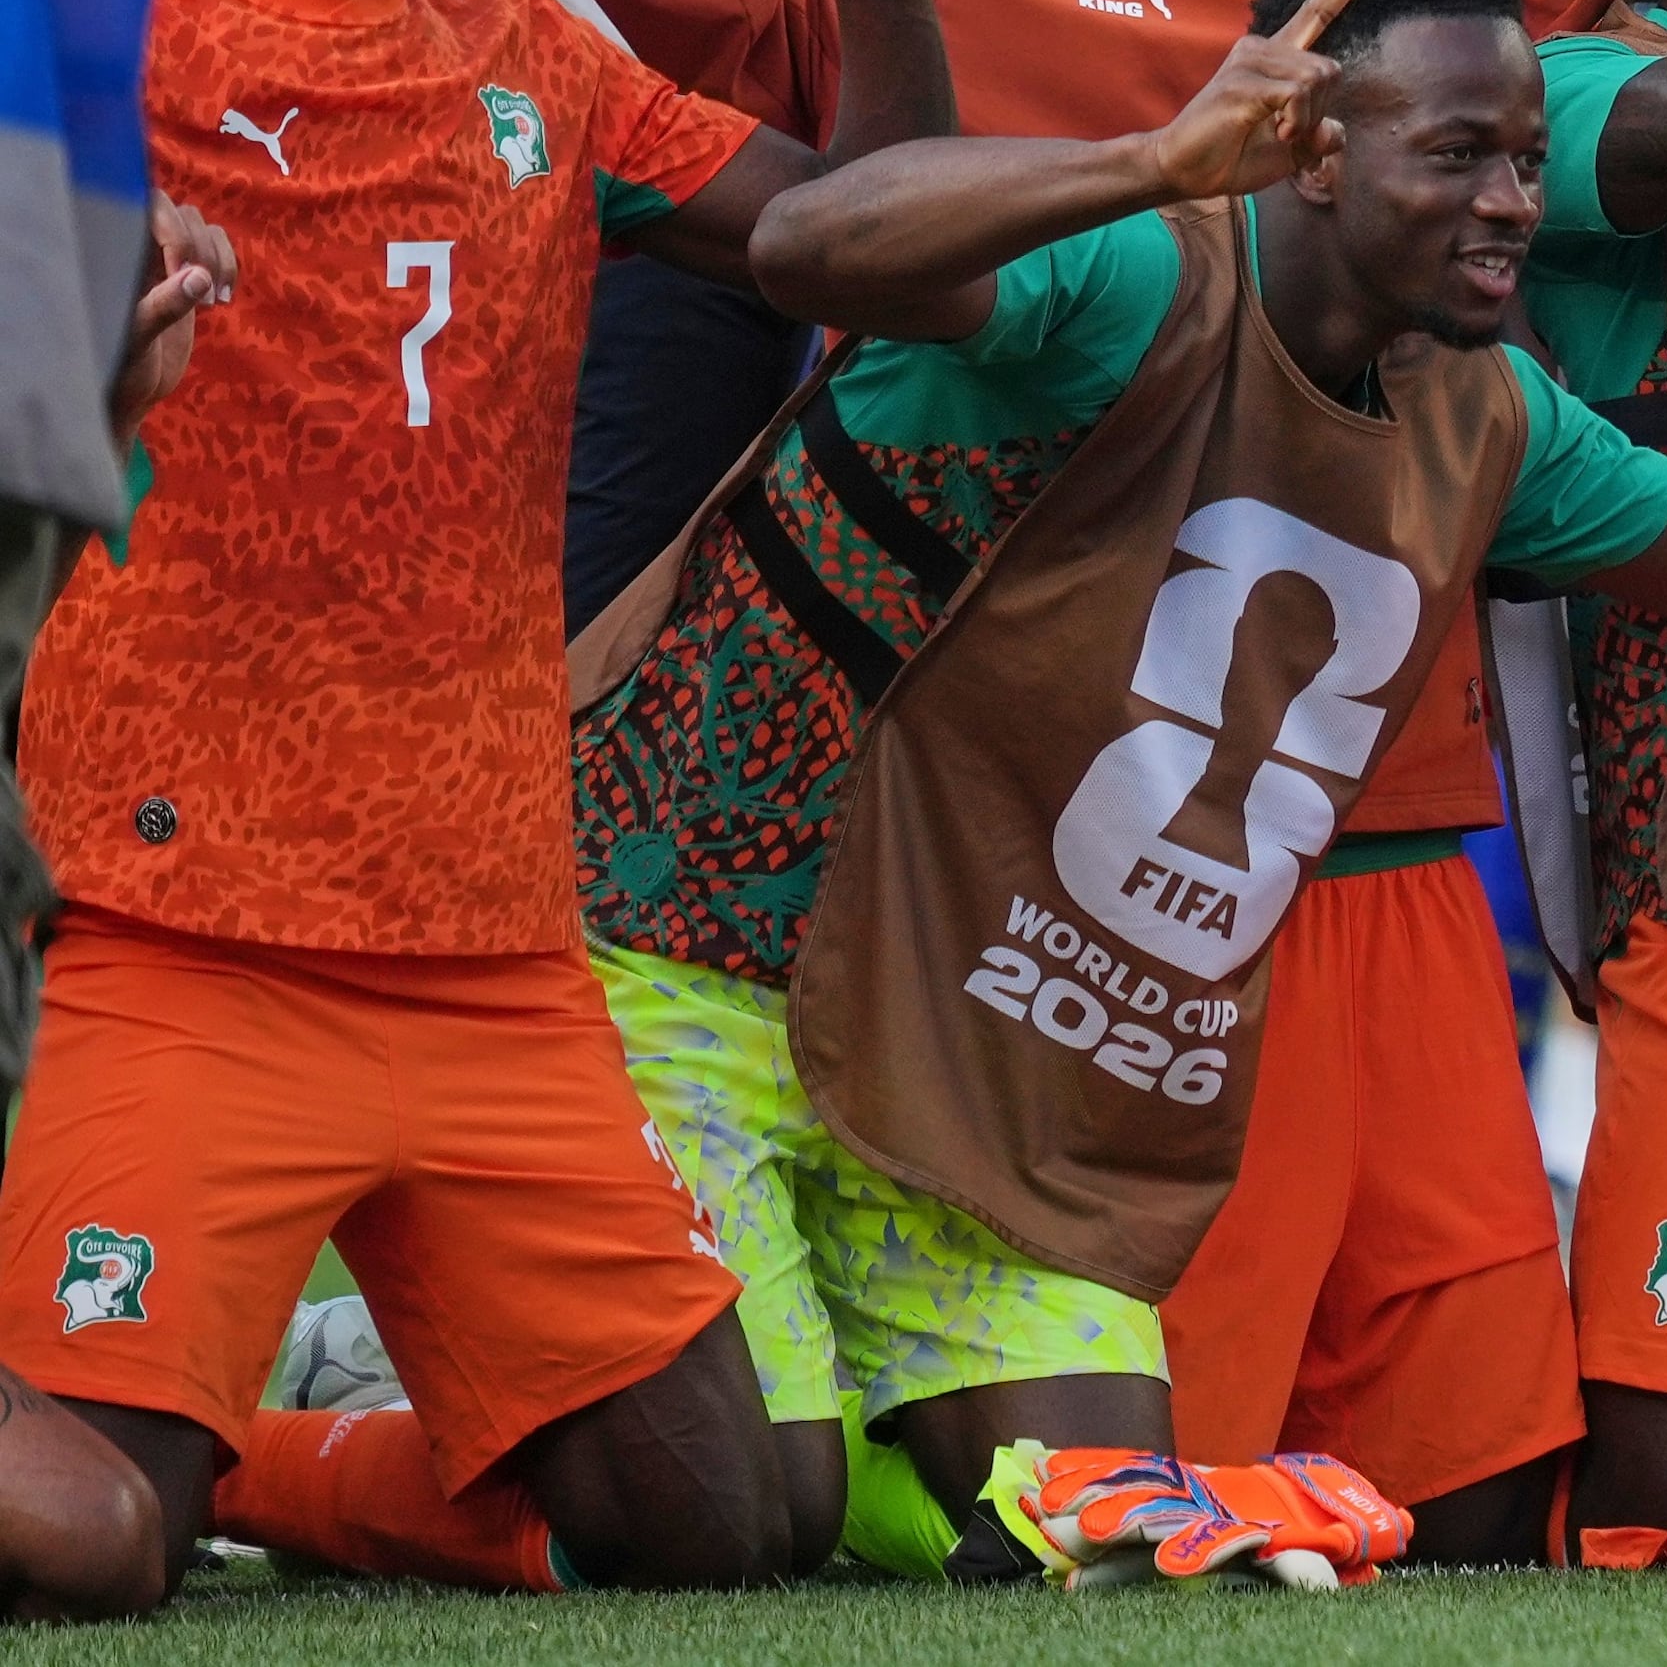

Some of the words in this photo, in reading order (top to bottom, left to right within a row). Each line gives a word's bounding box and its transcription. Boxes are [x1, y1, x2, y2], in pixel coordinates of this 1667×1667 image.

[385, 240, 456, 428] 7
[1001, 893, 1170, 1018] WORLD
[1171, 997, 1240, 1039] CUP
[1119, 854, 1238, 942] FIFA
[962, 942, 1229, 1106] 2026
